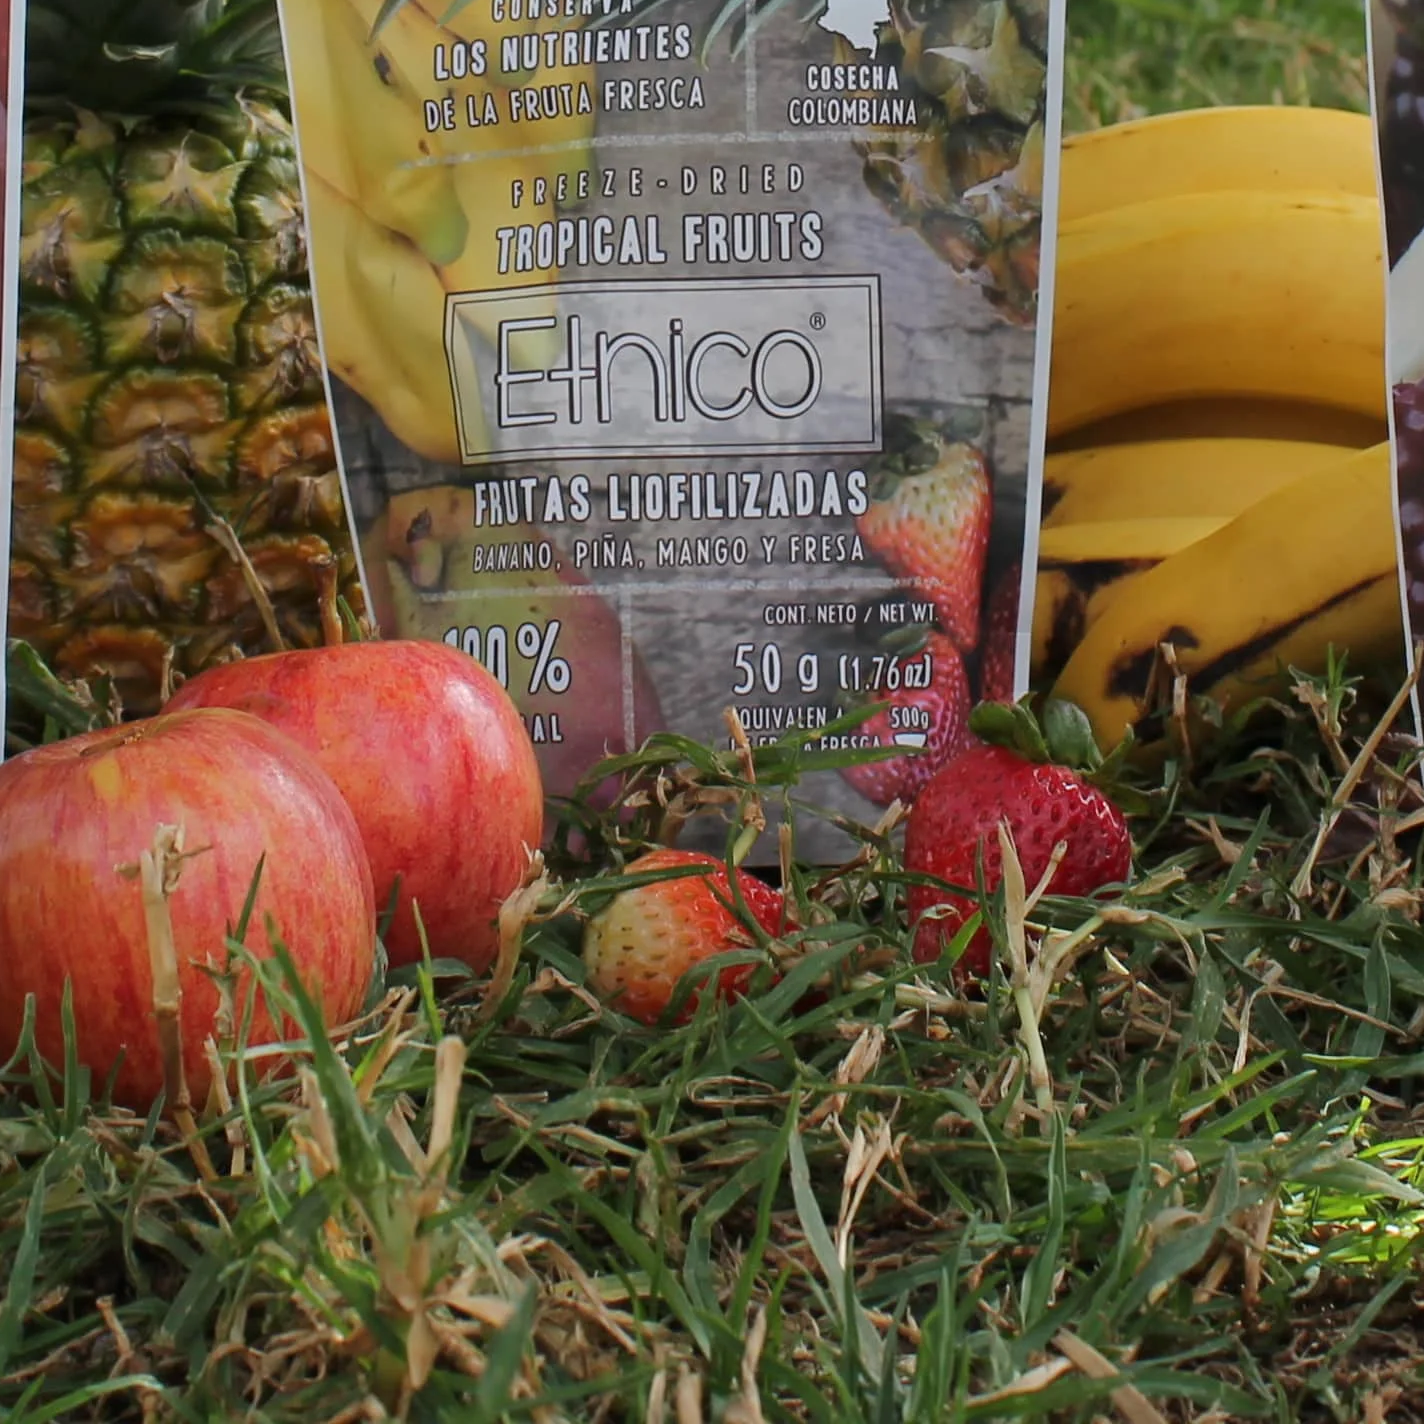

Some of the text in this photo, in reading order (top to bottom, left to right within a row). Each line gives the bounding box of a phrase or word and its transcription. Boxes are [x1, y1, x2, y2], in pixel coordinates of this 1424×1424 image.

[433, 23, 692, 81] LOS NUTRIENTES
[806, 64, 900, 93] COSECHA
[423, 77, 705, 132] DE LA FRUTA FRESCA
[788, 97, 919, 127] COLOMBIANA
[496, 211, 824, 274] TROPICAL FRUITS
[473, 469, 869, 529] FRUTAS LIOFILIZADAS
[473, 532, 865, 574] BANANO, PIÑA, MANGO Y FRESA
[764, 602, 940, 625] CONT. NETO / NET WT.
[732, 642, 782, 696] 50
[797, 652, 819, 693] g
[734, 707, 827, 729] QUIVALEN
[890, 707, 929, 729] 500g
